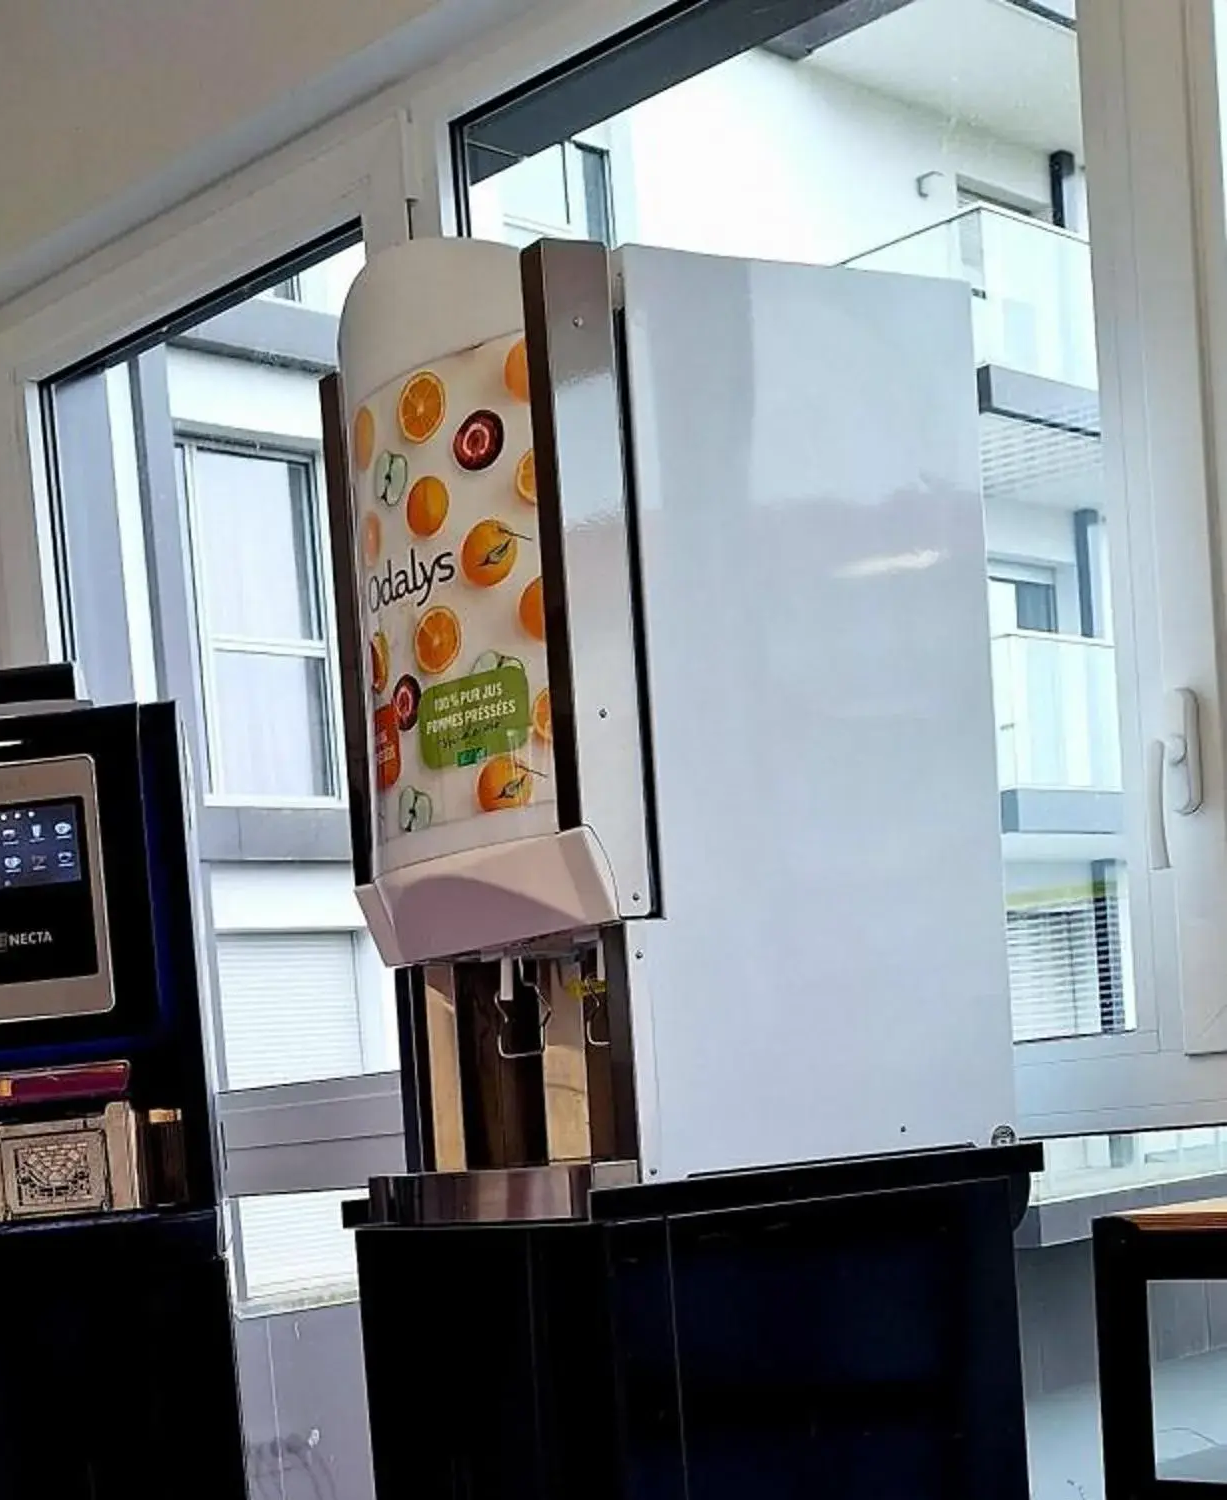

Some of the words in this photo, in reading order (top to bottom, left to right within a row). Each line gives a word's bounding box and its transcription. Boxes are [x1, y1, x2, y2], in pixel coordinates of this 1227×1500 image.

[369, 548, 455, 613] Odalys
[460, 687, 481, 705] PUR
[482, 681, 502, 699] JUS
[8, 931, 53, 946] NECTA
